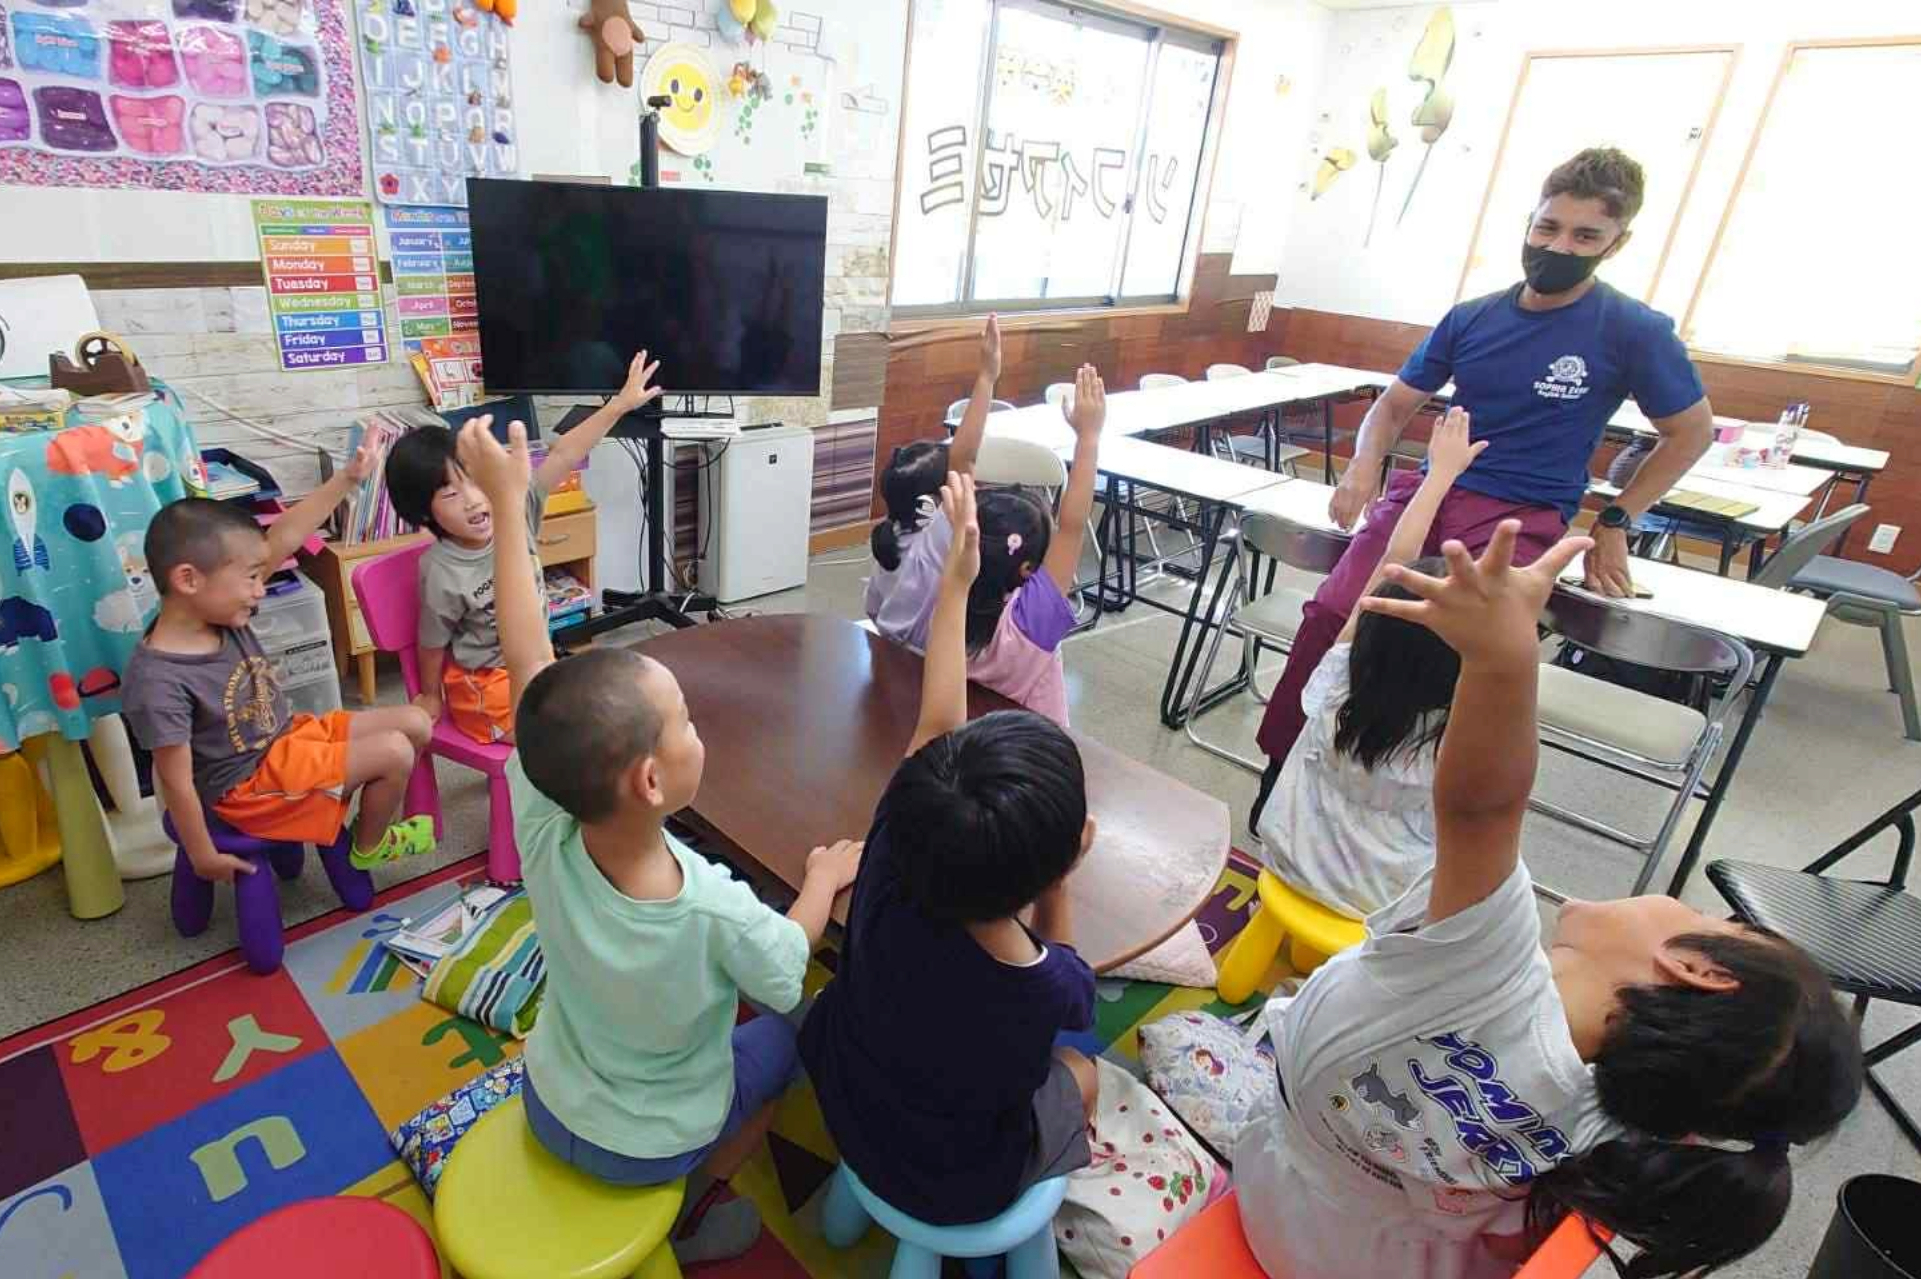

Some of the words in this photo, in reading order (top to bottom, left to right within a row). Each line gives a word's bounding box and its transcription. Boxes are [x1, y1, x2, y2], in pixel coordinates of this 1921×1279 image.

[398, 18, 418, 48] E
[269, 238, 316, 254] Sunday
[272, 256, 325, 272] Monday
[275, 274, 329, 290] Tuesday
[279, 296, 352, 309] Wednesday
[281, 314, 340, 329] Thursday
[283, 331, 326, 347] Friday
[287, 350, 348, 366] Saturday
